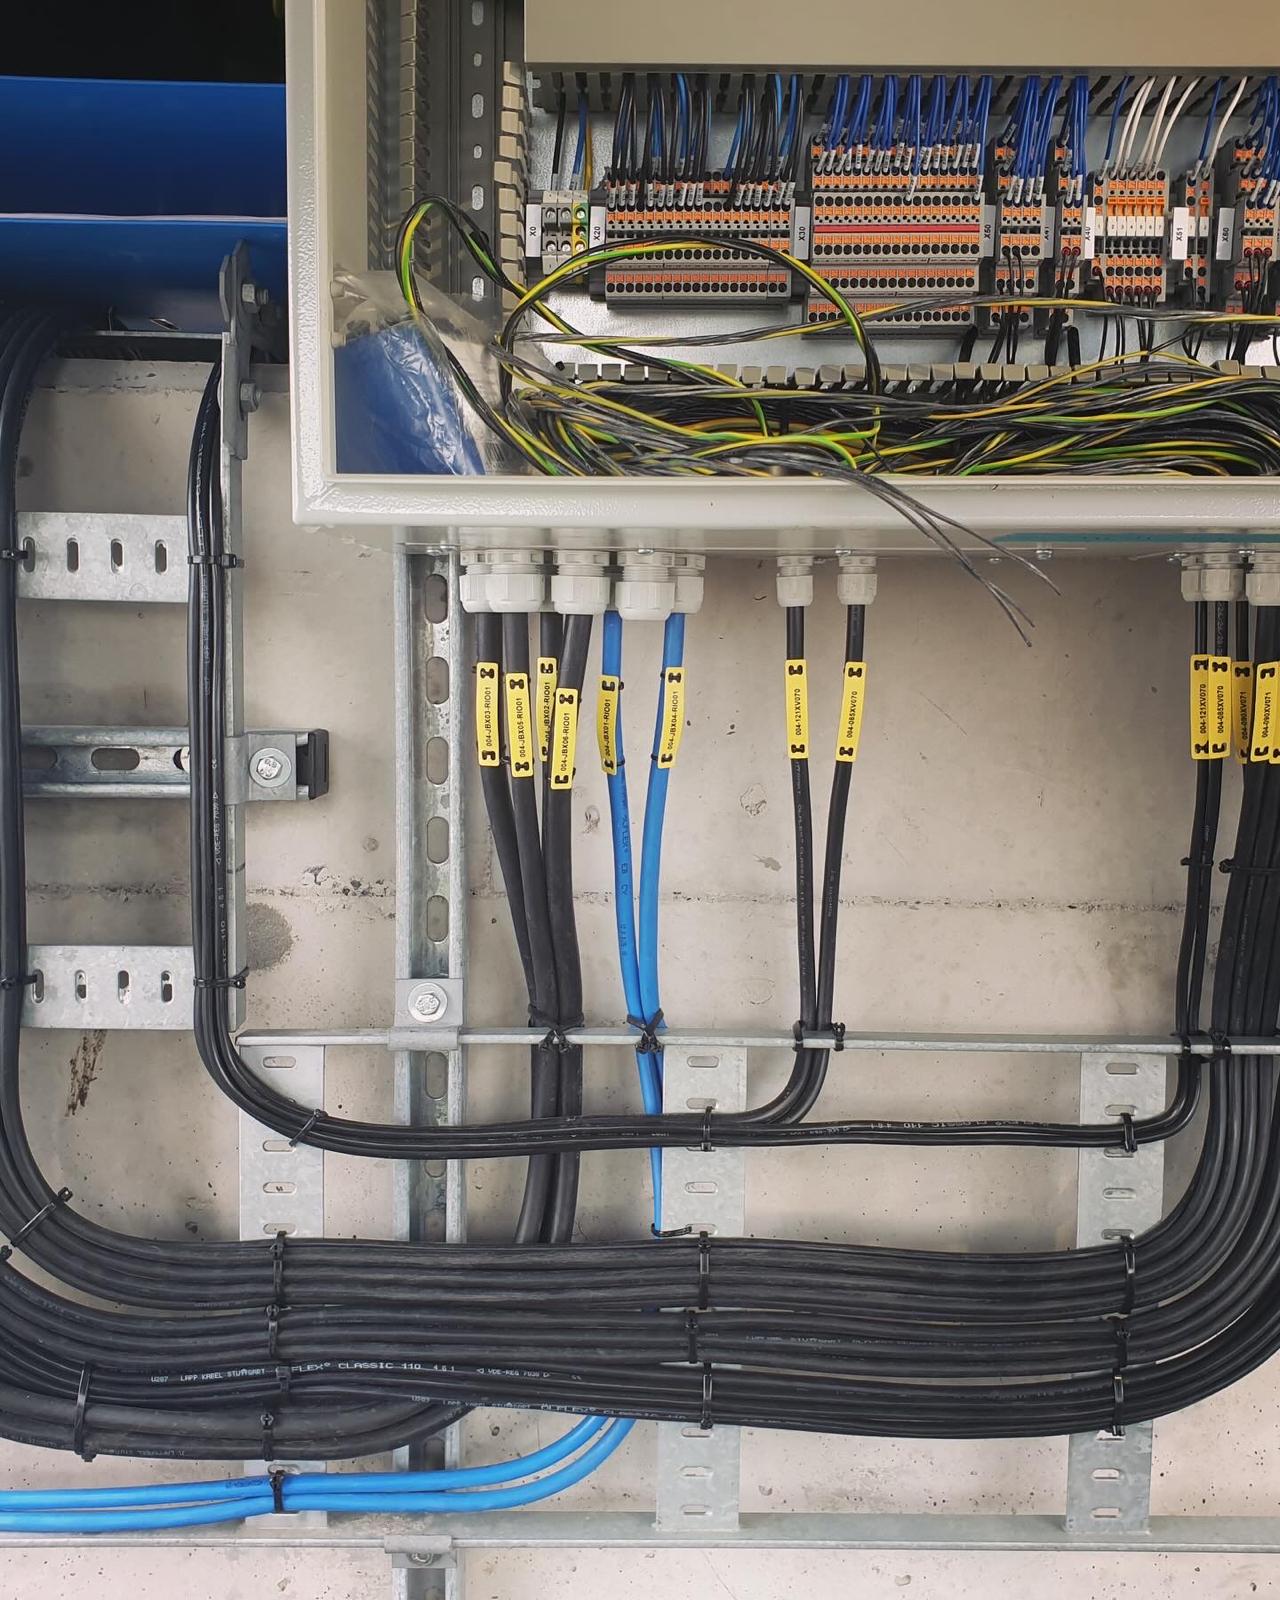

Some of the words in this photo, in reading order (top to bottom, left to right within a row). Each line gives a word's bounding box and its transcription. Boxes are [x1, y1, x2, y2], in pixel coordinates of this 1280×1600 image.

[529, 226, 537, 237] X0
[593, 226, 601, 241] X20
[798, 226, 806, 241] X30
[484, 686, 493, 747] 004-JBX03-RIO01
[516, 697, 526, 758] 004-JBX05-RIO01
[603, 698, 611, 756] 004-JBX01-RIO01
[667, 691, 679, 750] 004-JBX04-RIO01
[794, 689, 802, 735] 004-121XV070
[559, 712, 570, 772] 004-JBX06-RIO01
